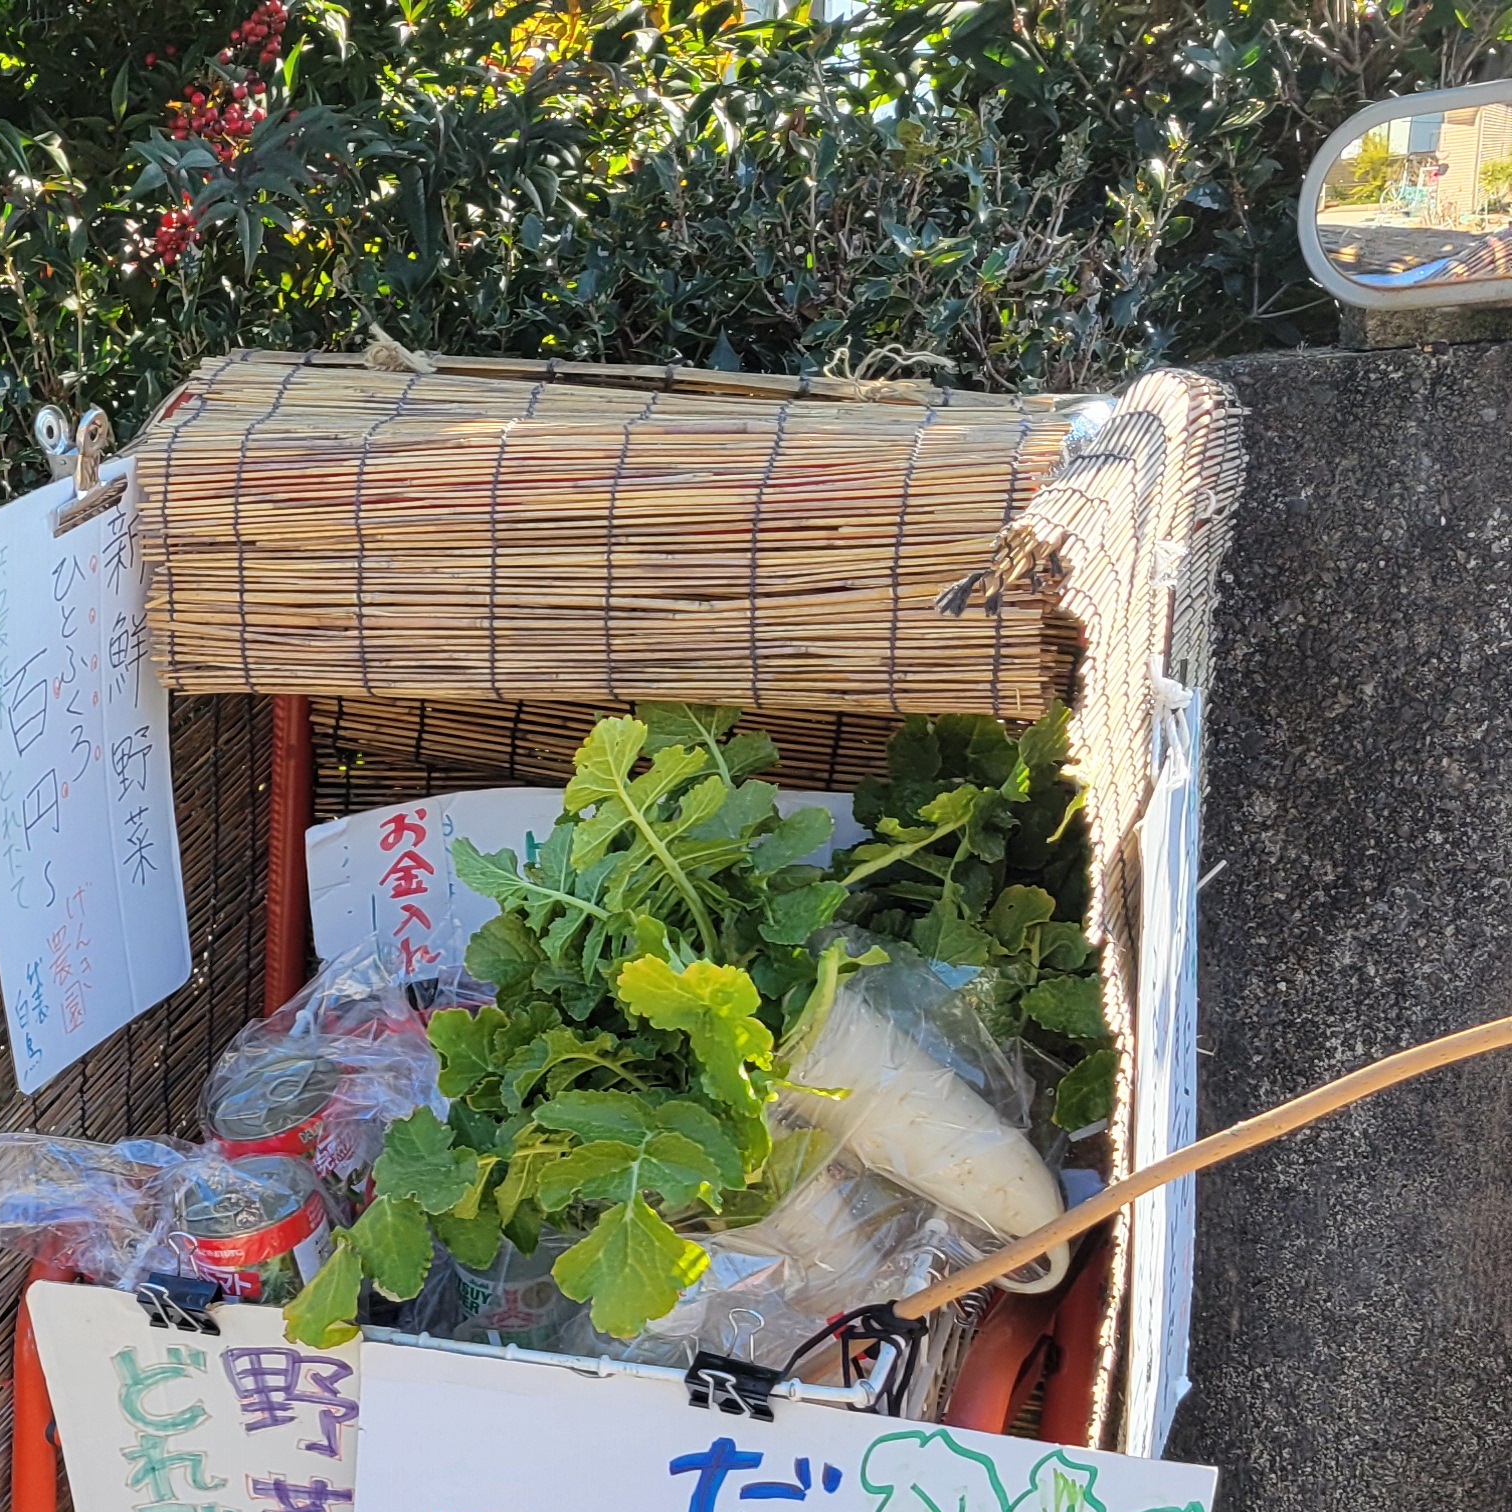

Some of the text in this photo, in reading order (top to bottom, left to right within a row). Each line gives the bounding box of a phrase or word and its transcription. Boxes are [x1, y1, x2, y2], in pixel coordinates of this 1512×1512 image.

[51, 554, 92, 783] ひとふくろ
[378, 806, 442, 976] お金入れ
[46, 924, 87, 1036] 農園
